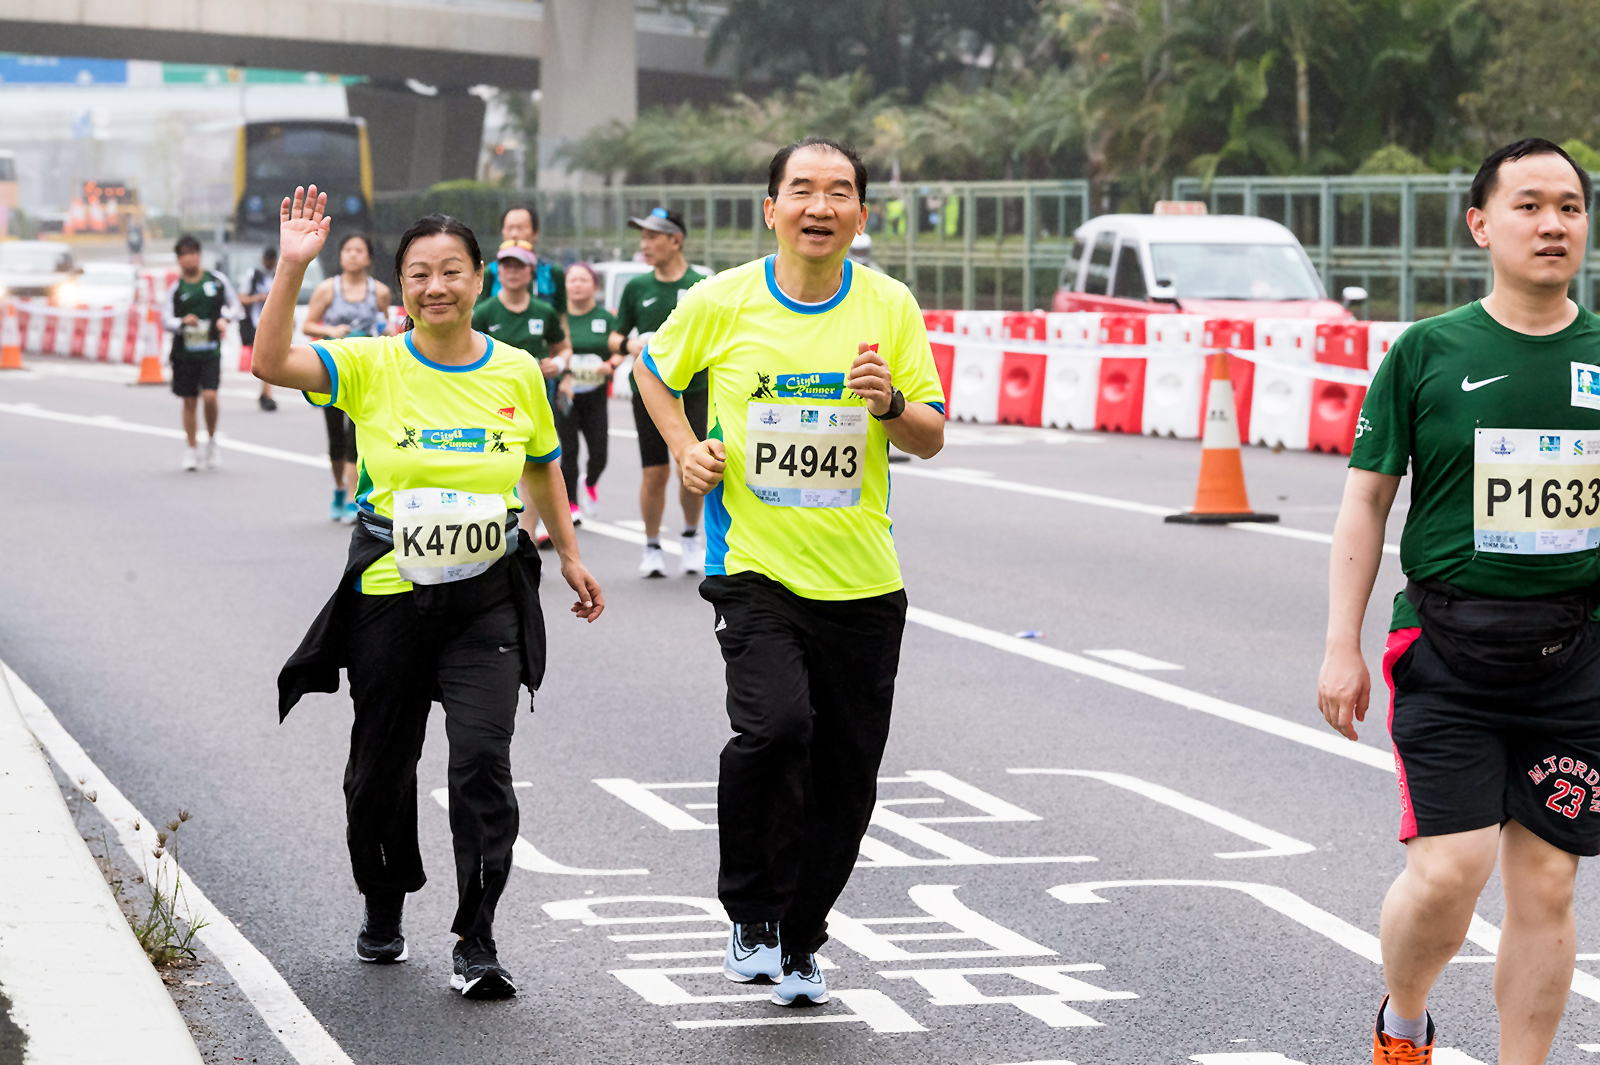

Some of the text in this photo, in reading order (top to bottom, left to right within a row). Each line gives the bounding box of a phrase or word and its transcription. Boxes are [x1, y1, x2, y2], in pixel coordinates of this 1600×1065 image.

[786, 375, 820, 390] CityU
[794, 384, 836, 396] Runner
[430, 429, 463, 443] CityU
[438, 440, 478, 450] Runner
[755, 442, 858, 478] P4943
[1487, 478, 1600, 519] P1633
[402, 521, 501, 557] K4700
[1546, 778, 1586, 819] 23
